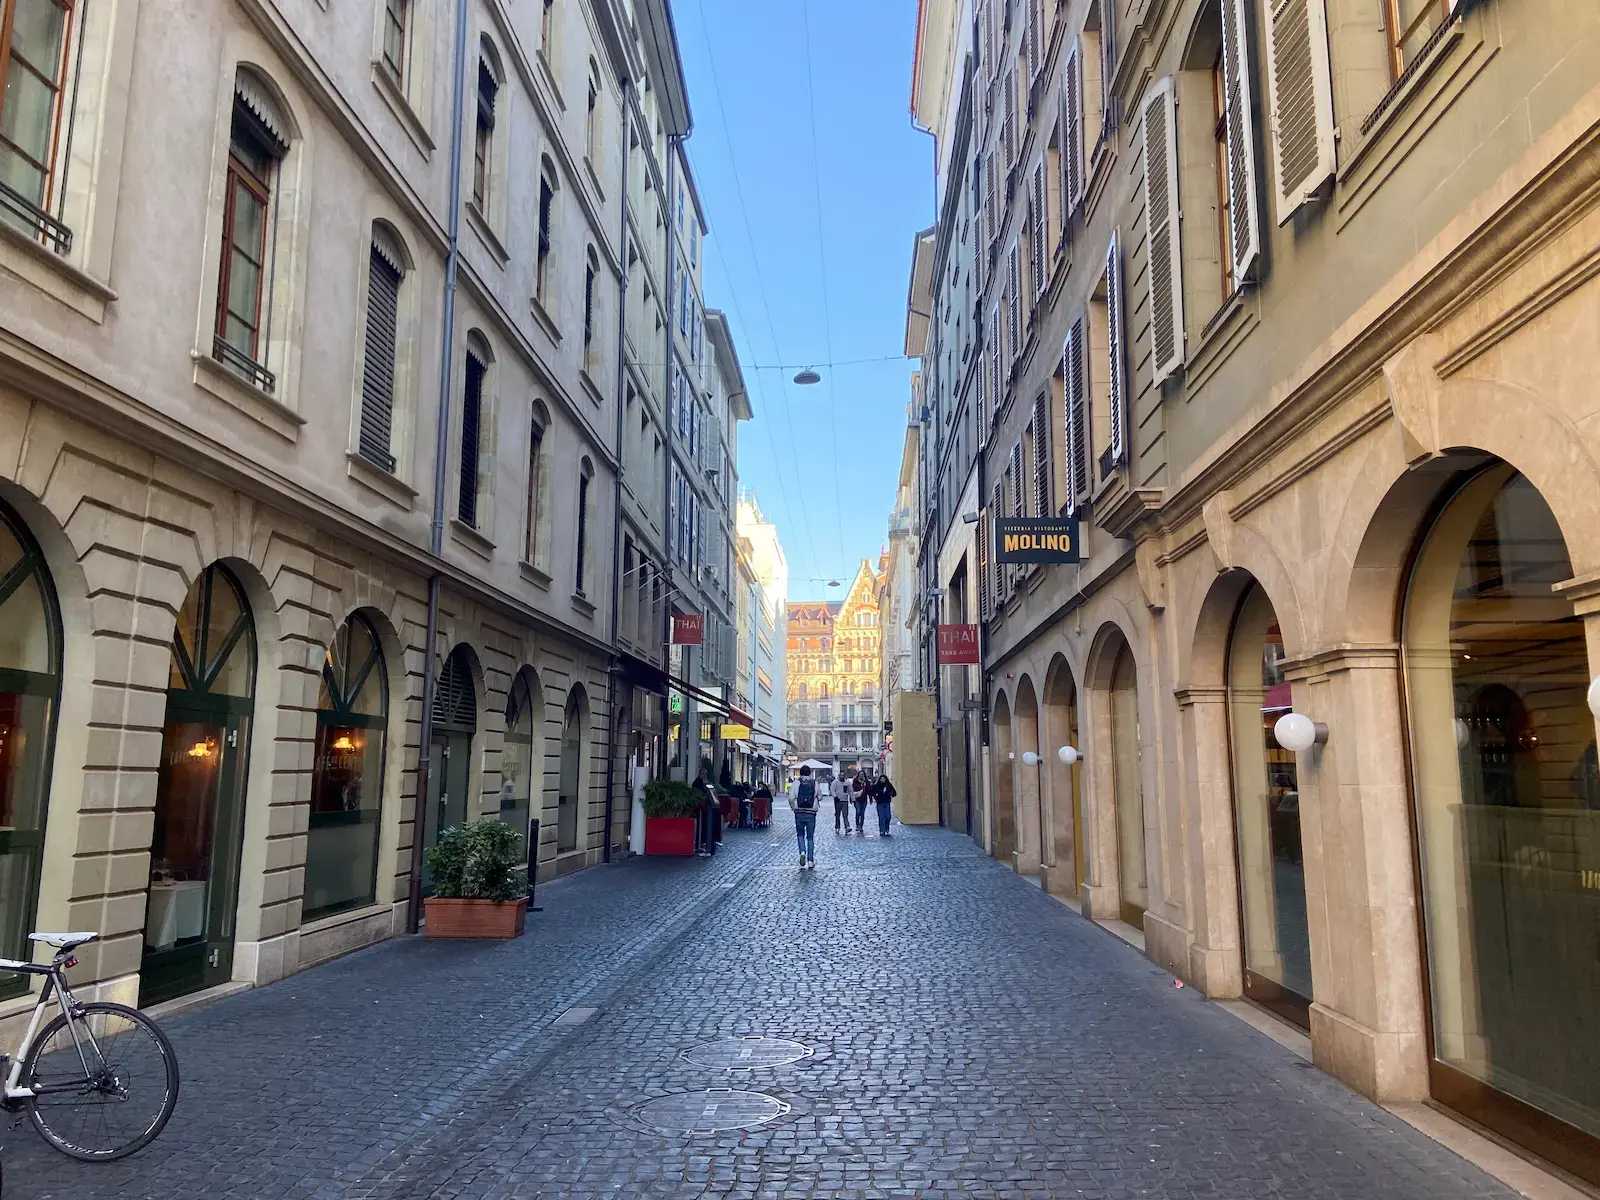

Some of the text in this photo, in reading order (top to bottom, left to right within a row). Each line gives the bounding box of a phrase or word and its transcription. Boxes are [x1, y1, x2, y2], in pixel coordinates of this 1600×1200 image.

[1004, 534, 1070, 553] MOLINO
[675, 615, 701, 629] THAÏ
[940, 624, 976, 643] THAÏ
